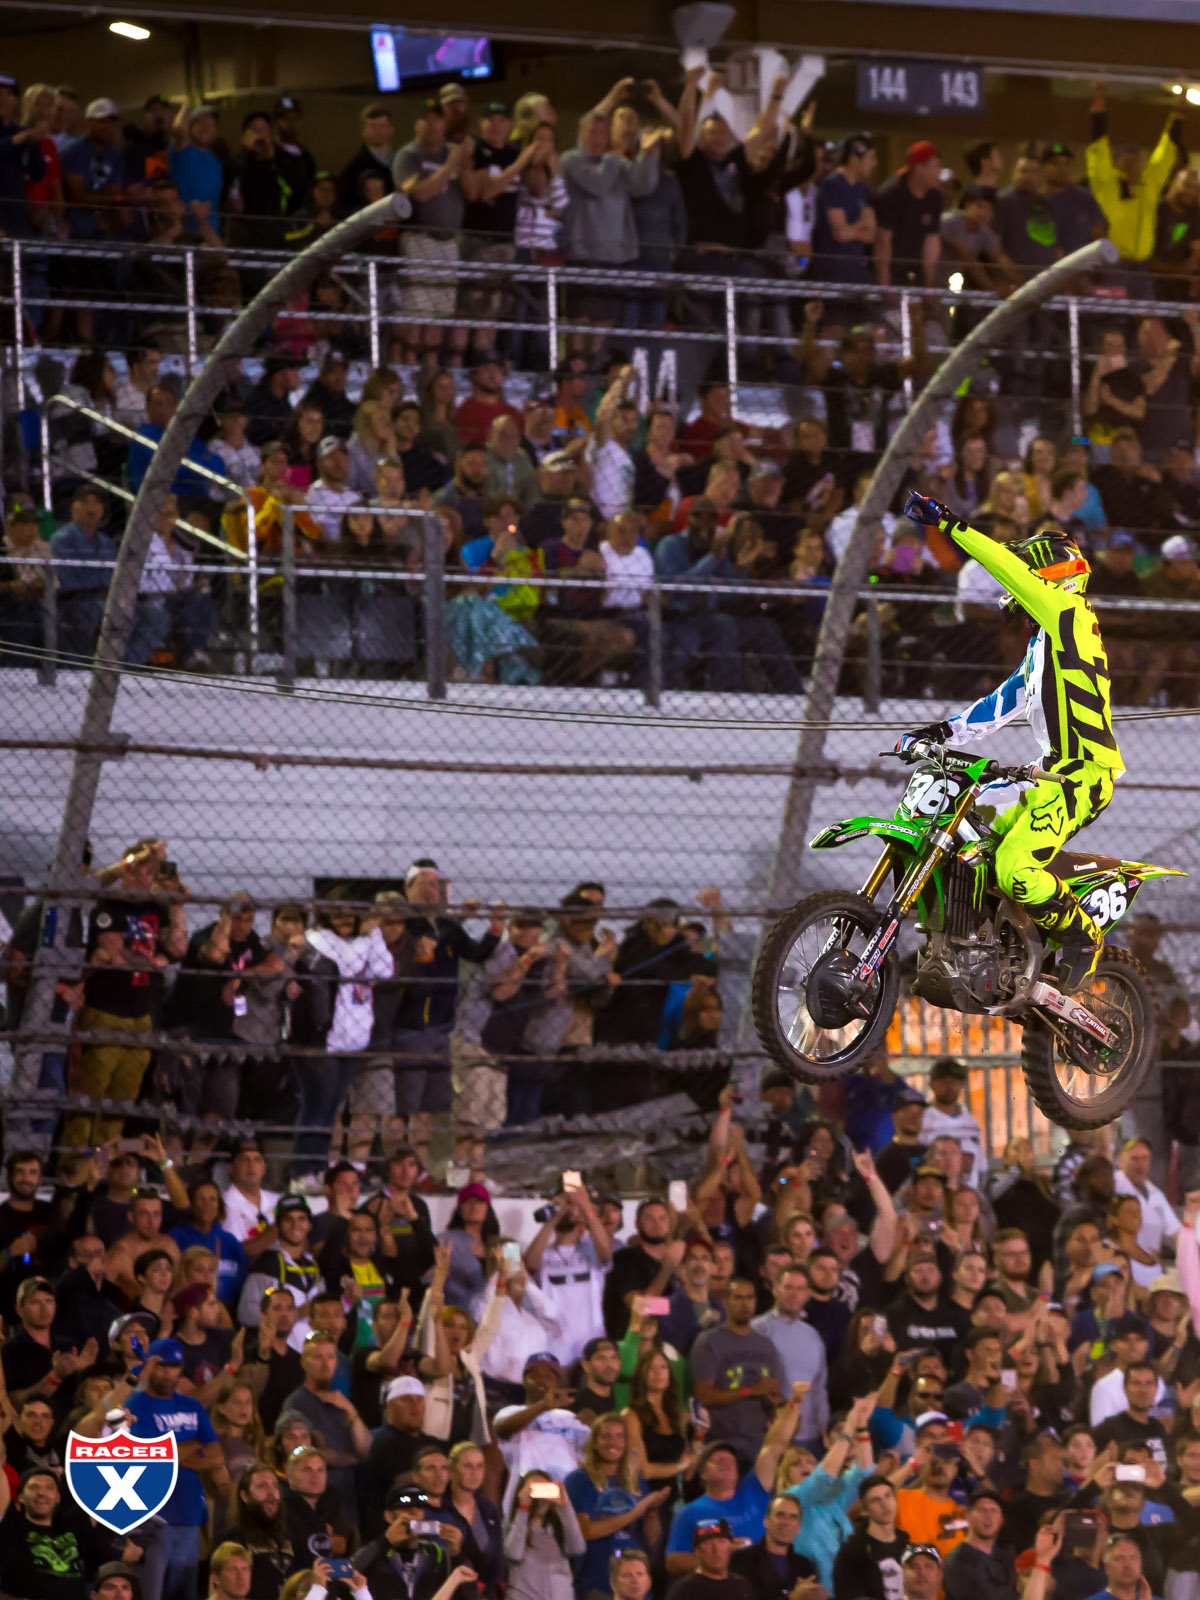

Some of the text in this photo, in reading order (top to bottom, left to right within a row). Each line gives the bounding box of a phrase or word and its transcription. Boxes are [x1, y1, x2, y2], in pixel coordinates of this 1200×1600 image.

[869, 66, 979, 107] 144 143
[902, 774, 960, 815] 36
[906, 877, 920, 898] PRO
[1091, 882, 1127, 927] 36
[852, 926, 882, 977] DUNLOP
[1070, 1007, 1107, 1036] RENTHAL
